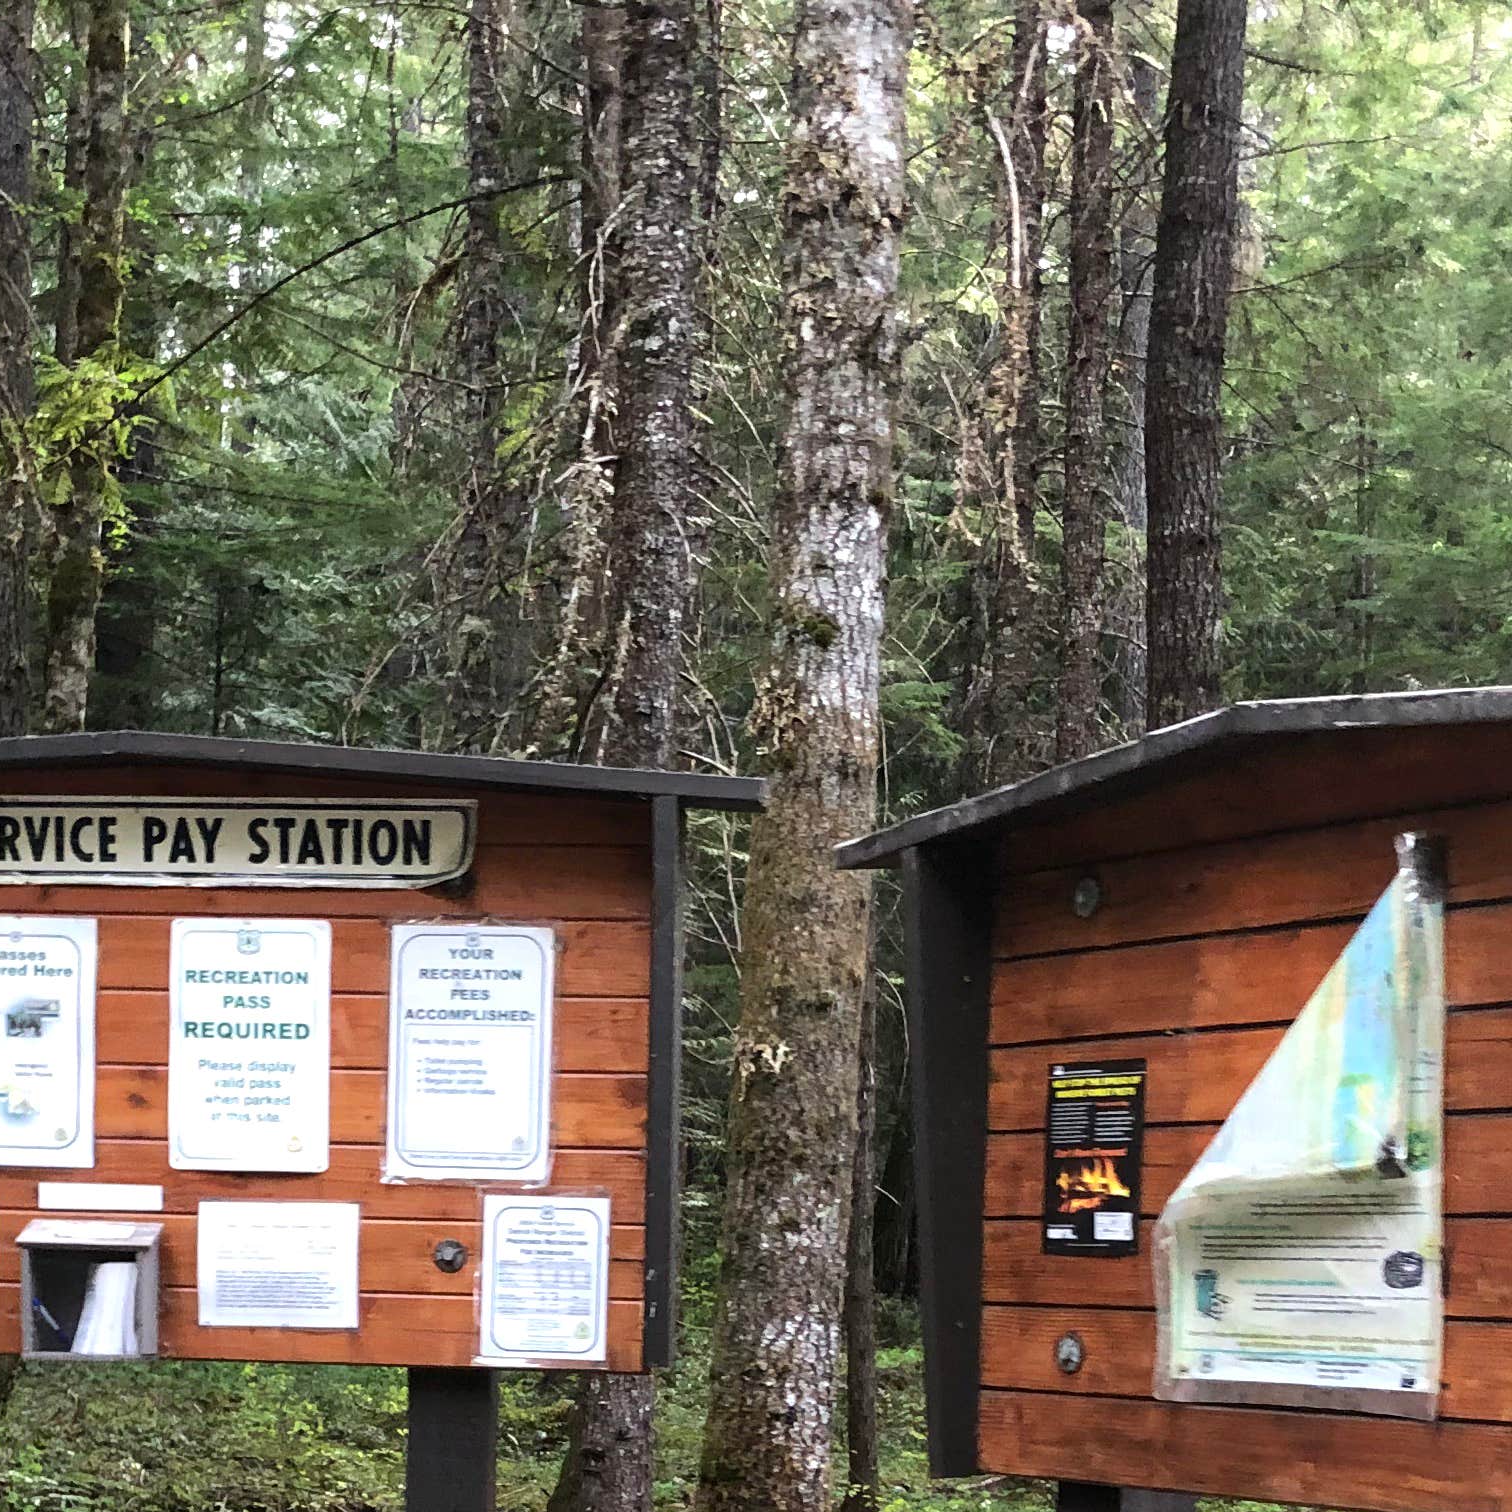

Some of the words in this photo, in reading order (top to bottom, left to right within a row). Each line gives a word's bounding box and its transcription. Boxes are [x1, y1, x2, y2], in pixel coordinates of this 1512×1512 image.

[143, 816, 224, 864] PAY
[247, 817, 431, 866] STATION
[448, 949, 494, 960] YOUR
[34, 965, 73, 977] Here
[185, 969, 309, 985] RECREATION
[419, 968, 523, 981] RECREATION
[450, 989, 491, 1001] FEES
[223, 995, 271, 1009] PASS
[184, 1021, 310, 1040] REQUIRED
[198, 1058, 242, 1072] Please
[248, 1061, 297, 1074] display
[249, 1079, 282, 1090] pass
[244, 1095, 291, 1106] parked
